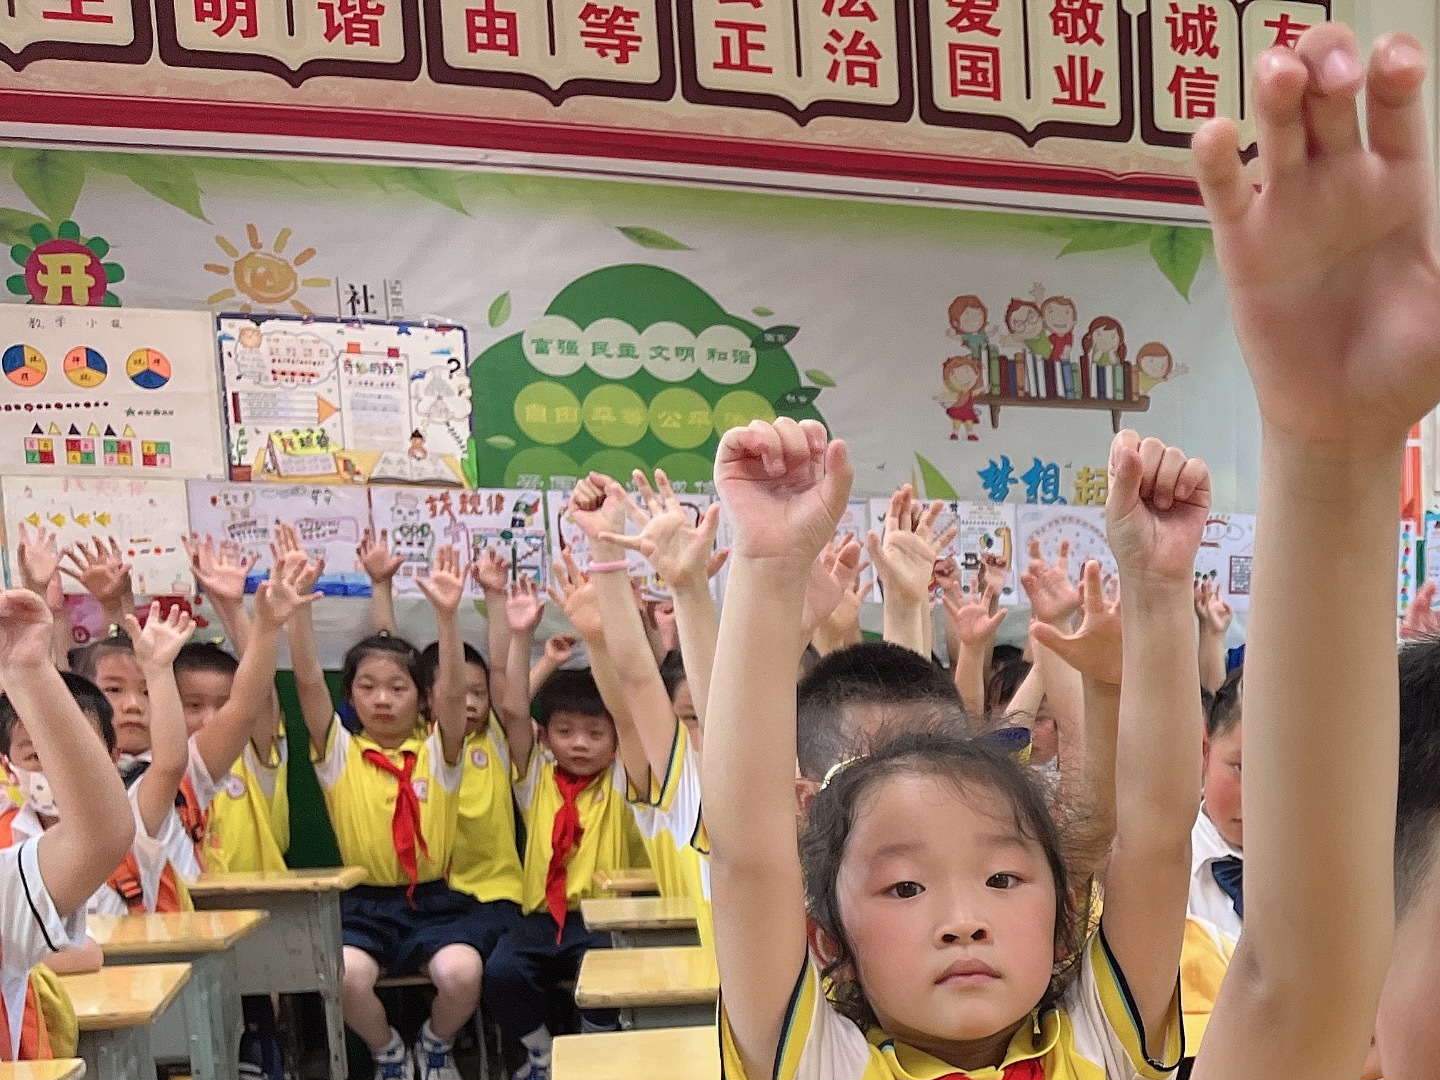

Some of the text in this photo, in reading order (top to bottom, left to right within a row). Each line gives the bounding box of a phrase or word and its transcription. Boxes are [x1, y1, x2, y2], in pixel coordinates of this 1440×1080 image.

[465, 0, 519, 57] 由
[578, 2, 642, 64] 等
[713, 0, 773, 74] 正
[946, 0, 1002, 101] 爱国
[1049, 0, 1106, 109] 敬业
[1165, 2, 1221, 119] 诚信
